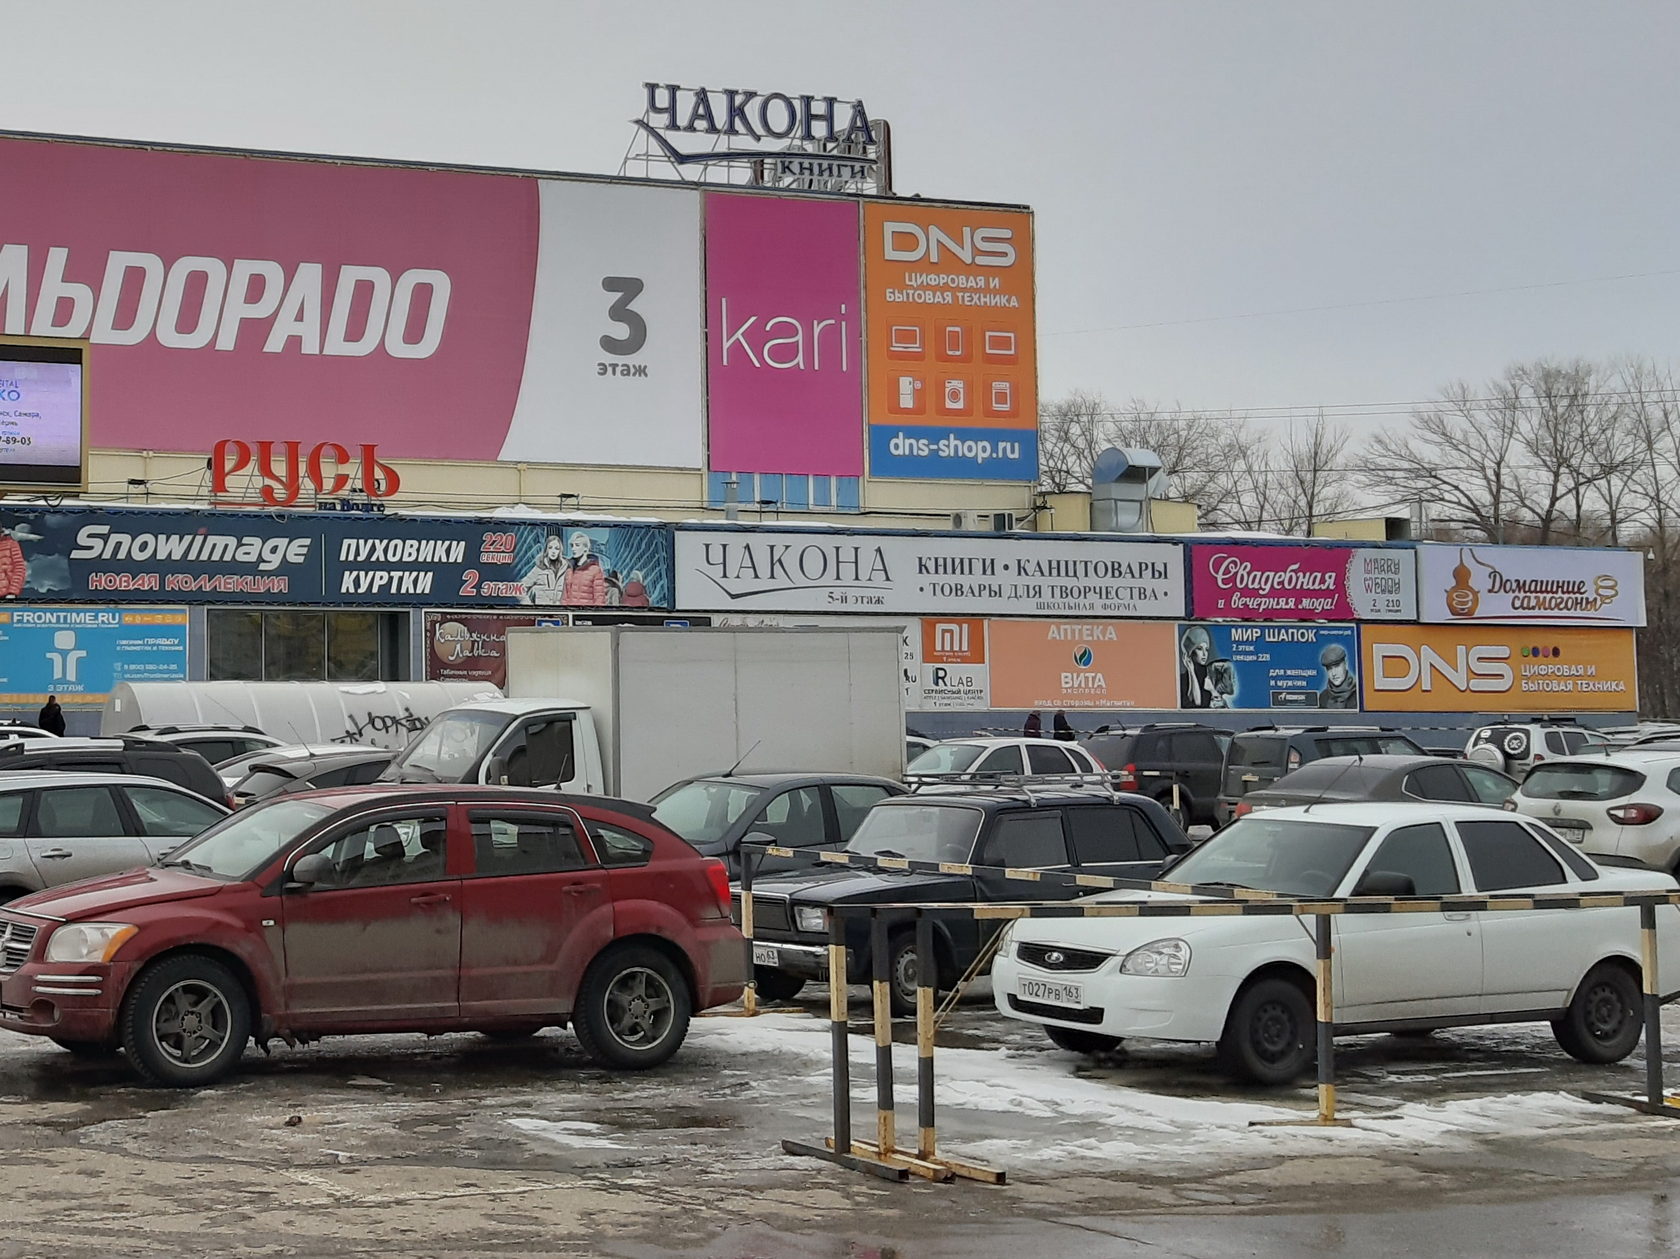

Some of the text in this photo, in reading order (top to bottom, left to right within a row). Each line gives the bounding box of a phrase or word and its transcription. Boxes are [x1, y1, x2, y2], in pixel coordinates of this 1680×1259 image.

[643, 83, 877, 145] ЧАКОНА
[883, 221, 1016, 267] DNS
[905, 272, 1000, 289] ЦИФРОВАЯ И
[886, 288, 1019, 308] БЫТОВАЯ ТЕХНИКА
[600, 276, 647, 356] 3
[721, 297, 848, 372] kari
[597, 360, 648, 378] этаж
[888, 432, 1020, 464] dns-shop.ru
[70, 525, 311, 571] Snowimage
[339, 532, 516, 563] ПУХОВИКИ 220
[703, 543, 894, 584] ЧАКОНА
[917, 556, 1169, 581] КНИГИ КАНЦТОВАРЫ
[1209, 553, 1336, 594] Свадебная
[89, 572, 289, 593] НОВАЯ КОЛЛЕКЦИЯ
[340, 569, 527, 597] КУРТКИ 2 этаж
[929, 583, 1159, 601] ТОВАРЫ ДЛЯ ТВОРЧЕСТВА
[1488, 570, 1588, 595] Домашние
[827, 592, 885, 605] 5-й этаж
[1035, 602, 1137, 612] ШКОЛЬНАЯ ФОРМА
[1218, 592, 1338, 613] и вечерняя мода!
[1386, 598, 1401, 608] 210
[1511, 594, 1601, 612] самогоны
[13, 612, 120, 624] FRONTIME.RU
[436, 622, 506, 643] Кальянна
[1047, 624, 1117, 640] АПТЕКА
[1231, 628, 1317, 642] МИР ШАПОК
[448, 641, 500, 660] Лавка
[1372, 643, 1514, 692] DNS
[1521, 665, 1596, 678] ЦИФРОВАЯ И
[1061, 672, 1106, 688] ВИТА
[1521, 680, 1626, 692] БЫТОВАЯ ТЕХНИКА
[1022, 981, 1080, 1000] Т027РВ 163
